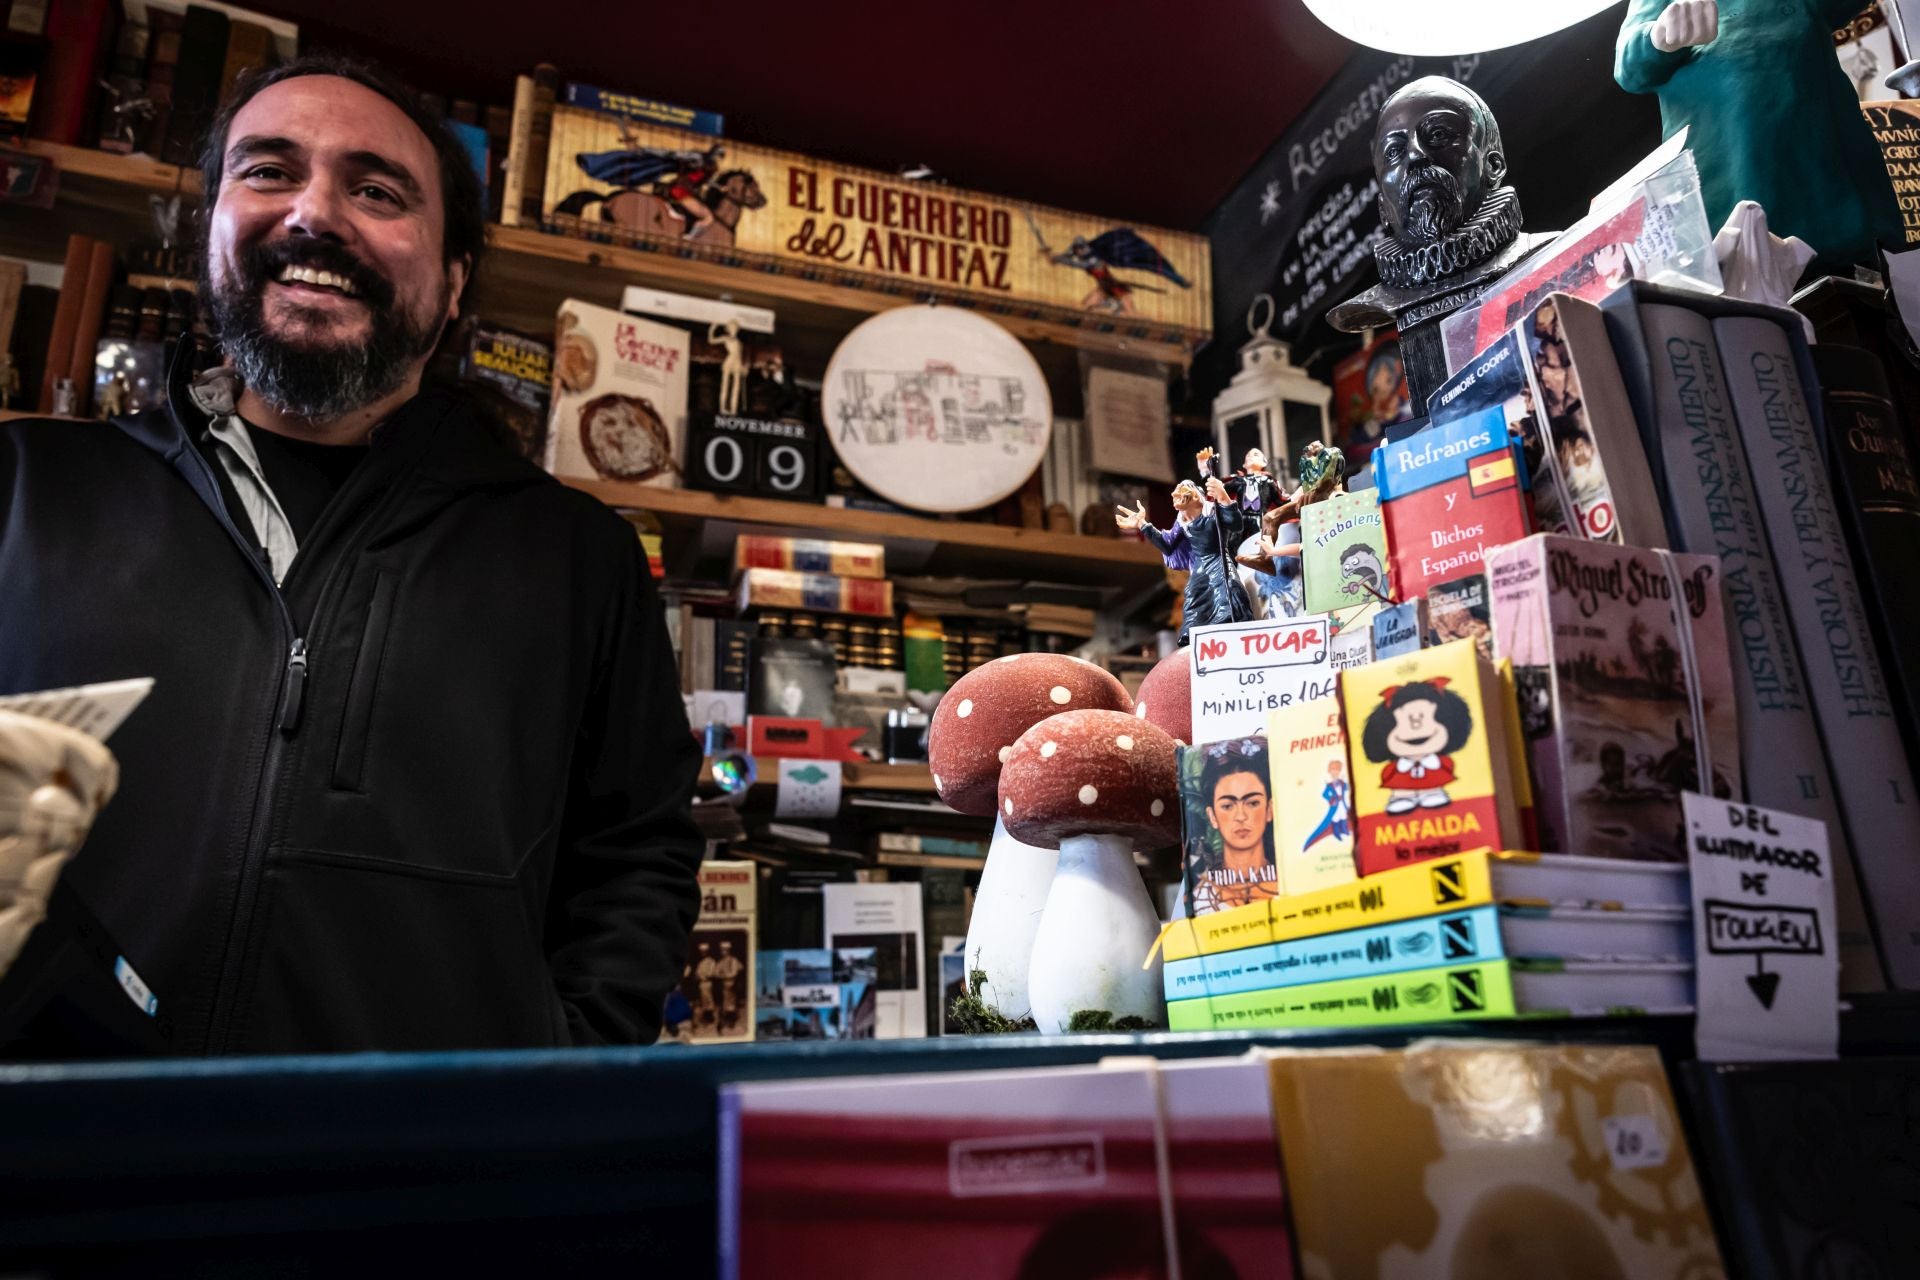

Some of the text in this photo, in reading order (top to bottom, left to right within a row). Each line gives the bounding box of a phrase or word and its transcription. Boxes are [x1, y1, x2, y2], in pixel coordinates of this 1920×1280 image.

[1288, 56, 1415, 192] RECOGEMOS
[788, 166, 1012, 249] EL GUERRERO
[786, 222, 1012, 292] del ANTIFAZ
[1441, 347, 1511, 407] FENIMORE COOPER
[714, 414, 805, 439] NOVEMBER
[1666, 336, 1737, 536] PENSAMIENTO
[1398, 430, 1492, 473] Refranes
[1750, 351, 1823, 546] PENSAMIENTO
[1444, 491, 1457, 512] y
[1431, 523, 1484, 550] Dichos
[1550, 550, 1624, 618] Miguel
[1386, 618, 1399, 632] LA
[1725, 564, 1785, 712] HISTORIA
[1200, 628, 1323, 661] NO TOCAR
[1813, 577, 1874, 718] HISTORIA
[1239, 671, 1265, 686] LOS
[1374, 812, 1482, 847] MAFALDA
[1727, 805, 1781, 836] DEL
[1394, 839, 1462, 861] lo mejor
[1207, 868, 1246, 887] FRIDA
[1740, 872, 1768, 896] DE
[1357, 885, 1385, 913] 100
[1364, 936, 1392, 964] 100
[1370, 984, 1399, 1013] 100
